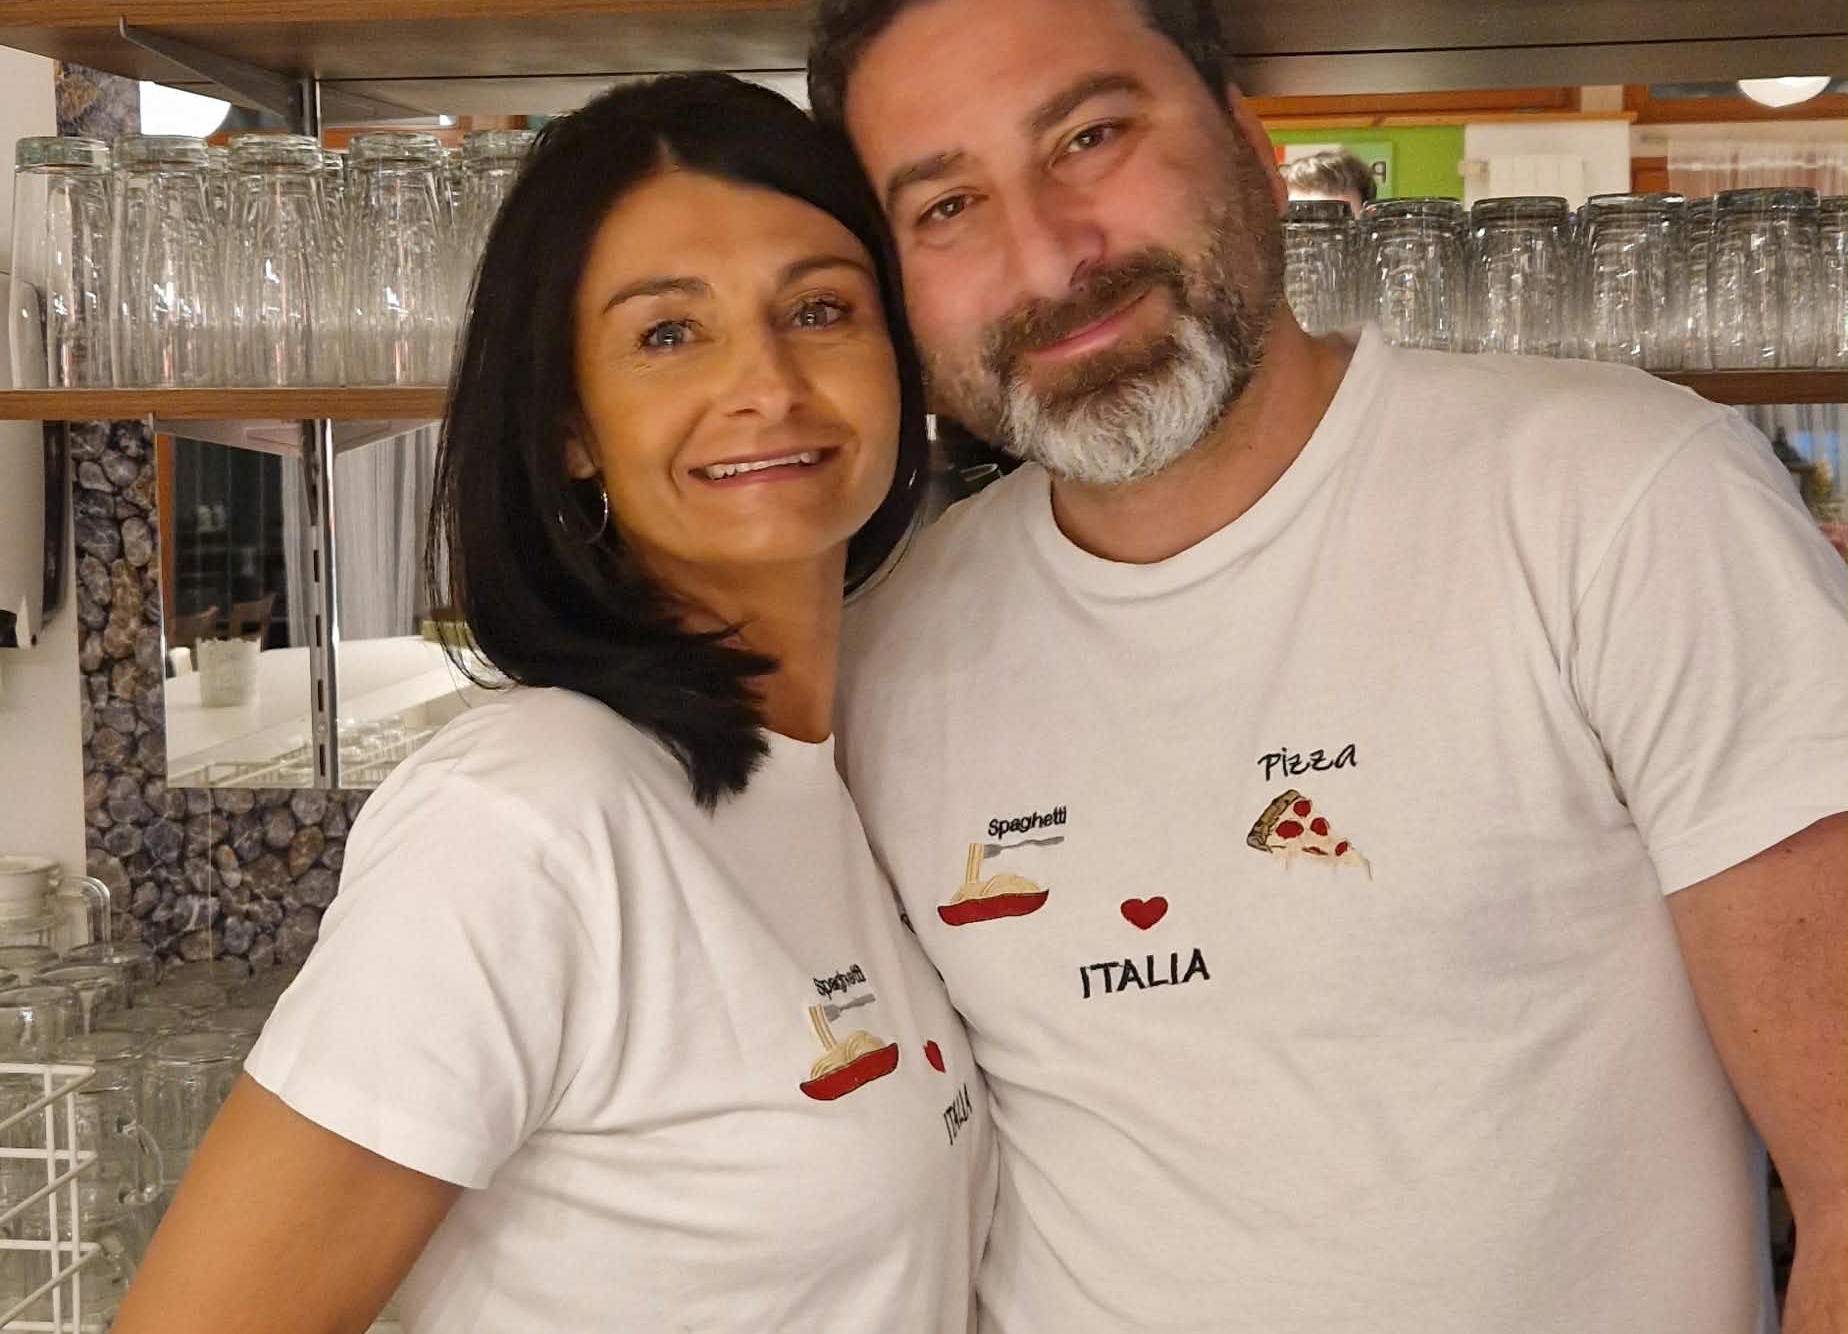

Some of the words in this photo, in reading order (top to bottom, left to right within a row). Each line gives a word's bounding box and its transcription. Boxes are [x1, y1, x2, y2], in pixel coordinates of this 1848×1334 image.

[1257, 742, 1359, 781] Pizza
[987, 804, 1067, 841] Spaghetti
[1079, 947, 1211, 999] ITALIA
